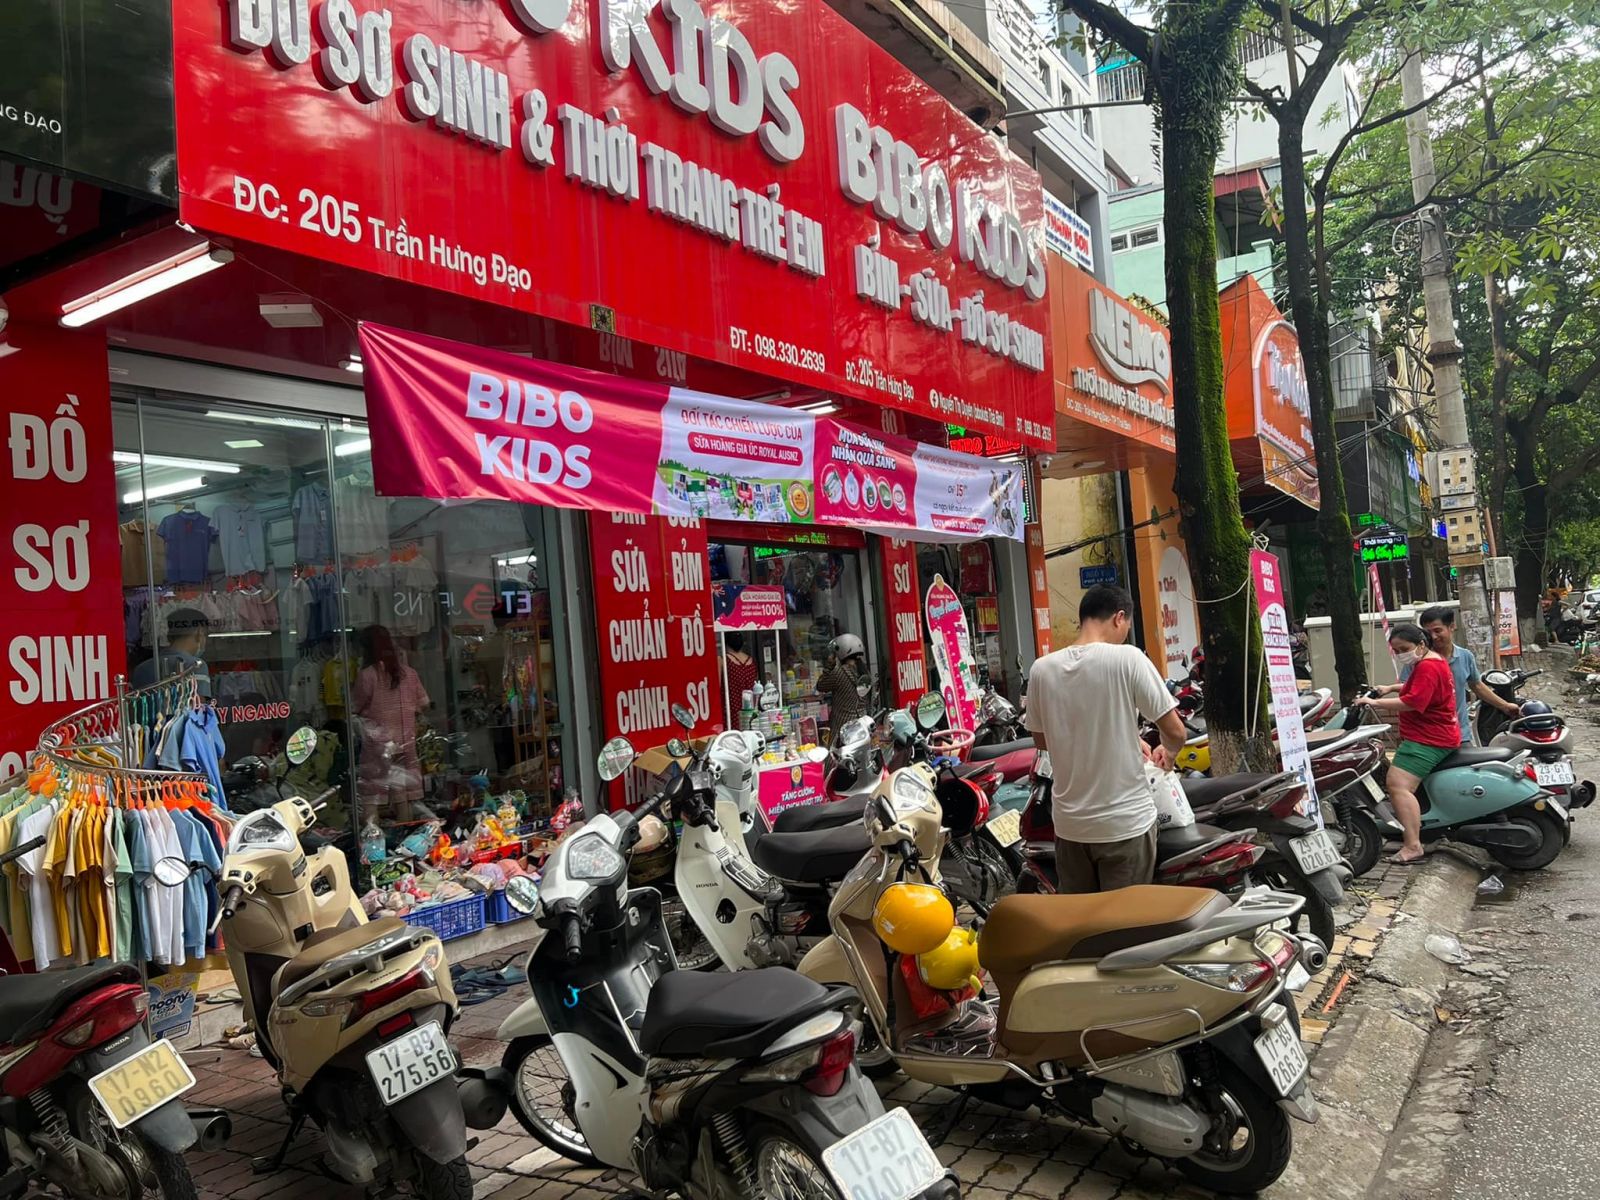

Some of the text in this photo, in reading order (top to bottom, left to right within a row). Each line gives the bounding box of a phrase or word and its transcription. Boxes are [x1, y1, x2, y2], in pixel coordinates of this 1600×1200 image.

[600, 0, 805, 170] KIDS
[403, 33, 512, 151] SINH
[521, 88, 555, 167] &
[558, 103, 639, 201] THỜI
[643, 141, 740, 243] TRANG
[738, 182, 788, 261] TRẺ
[784, 208, 826, 278] EM
[835, 102, 1047, 301] BIBO KIDS
[232, 176, 532, 292] ĐC: 205 Trần Hưng Đạo
[855, 236, 900, 310] BỈM
[910, 267, 953, 332] SỮA
[1008, 320, 1045, 373] SINH
[730, 326, 825, 373] ĐT: 098.330.2639
[1088, 287, 1171, 382] NEMO
[859, 358, 874, 388] 205
[1099, 376, 1127, 407] TRANG
[466, 371, 595, 434] BIBO
[681, 406, 701, 426] ĐỐI
[702, 411, 723, 430] TÁC
[724, 415, 757, 434] CHIẾN
[758, 421, 784, 440] LƯỢC
[8, 393, 88, 483] ĐỒ
[475, 433, 593, 489] KIDS
[693, 434, 710, 449] SỮA
[710, 438, 736, 451] HOÀNG
[736, 443, 749, 454] GIA
[749, 442, 759, 456] ÚC
[759, 446, 778, 459] ROYAL
[831, 443, 856, 464] NHẬN
[875, 456, 897, 470] SANG
[13, 519, 90, 592] SƠ
[611, 538, 650, 592] SỮA
[671, 538, 704, 591] BỈM
[893, 561, 910, 593] SƠ
[608, 598, 667, 663] CHUẨN
[682, 603, 706, 657] ĐỒ
[763, 604, 784, 617] 100%
[896, 612, 918, 643] SINH
[8, 635, 110, 705] SINH
[897, 653, 924, 692] CHÍNH
[232, 701, 291, 723] NGANG
[616, 680, 670, 735] CHÍNH
[686, 677, 710, 722] SƠ
[781, 789, 797, 802] TĂNG
[1301, 847, 1339, 870] 020.61
[696, 882, 719, 890] HONDA
[104, 1036, 130, 1053] HONDA
[380, 1030, 435, 1071] 17-B9
[119, 1070, 181, 1117] 0960
[381, 1049, 451, 1100] 275.56
[841, 1121, 905, 1176] 17-B7
